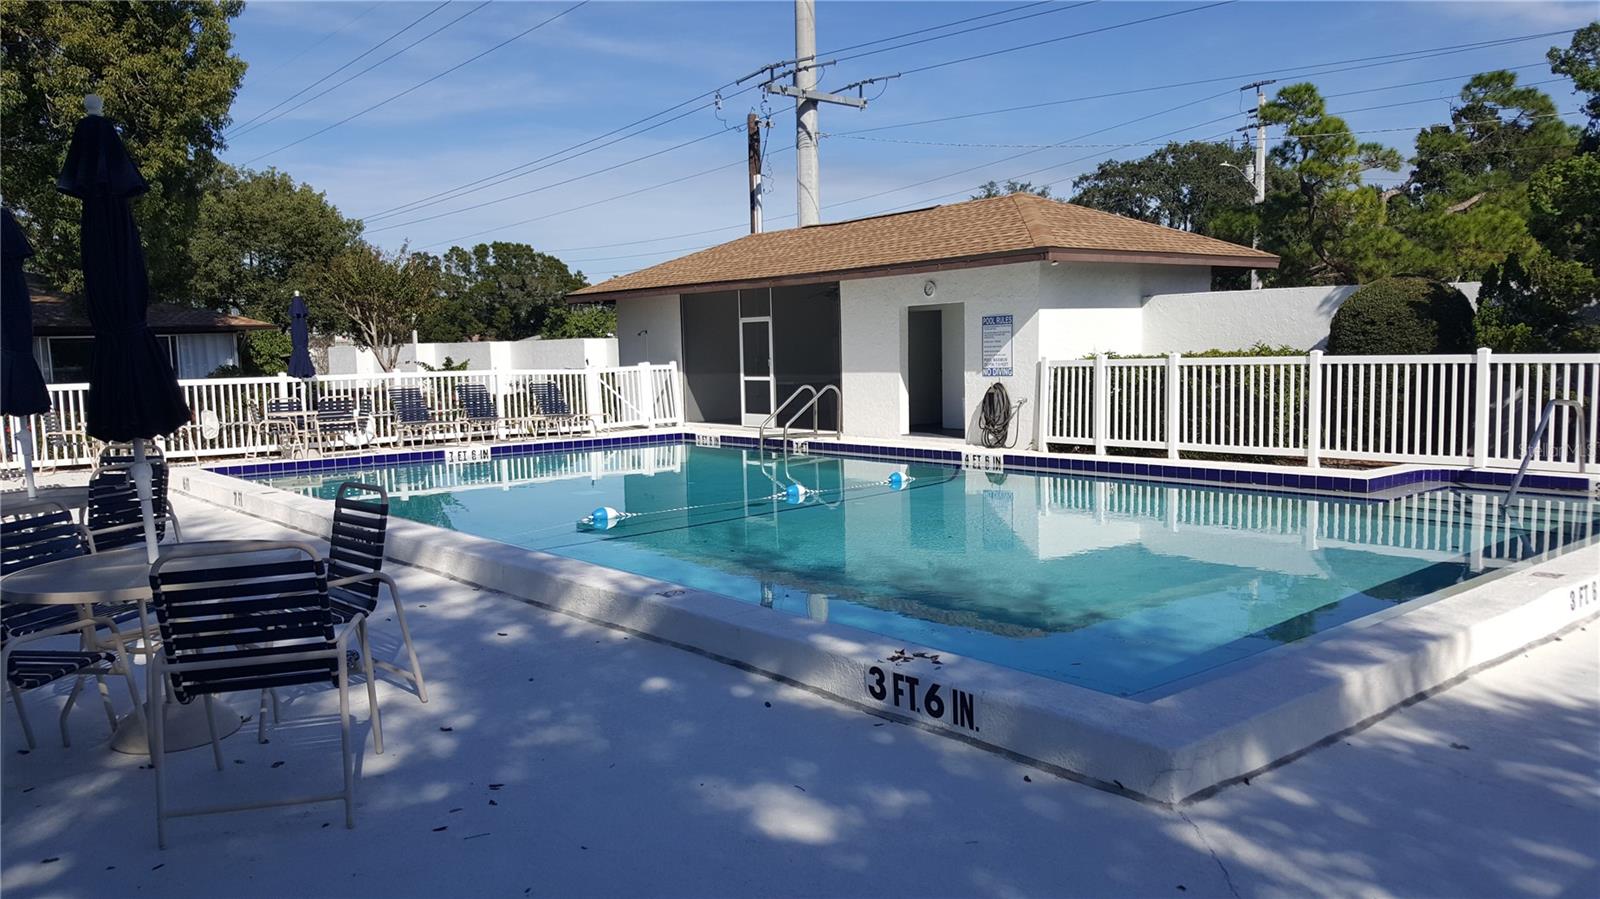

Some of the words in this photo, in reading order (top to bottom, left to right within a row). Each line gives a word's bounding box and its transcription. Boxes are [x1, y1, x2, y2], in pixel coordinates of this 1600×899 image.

[983, 317, 996, 325] POOL
[996, 315, 1012, 324] RULES
[983, 368, 992, 376] NO
[992, 367, 1012, 376] DIVING
[972, 454, 981, 466] FT
[992, 455, 1001, 467] IN
[1570, 590, 1576, 611] 3
[868, 666, 887, 701] 3
[892, 672, 920, 713] FT.
[924, 683, 945, 719] 6
[952, 688, 980, 732] IN.
